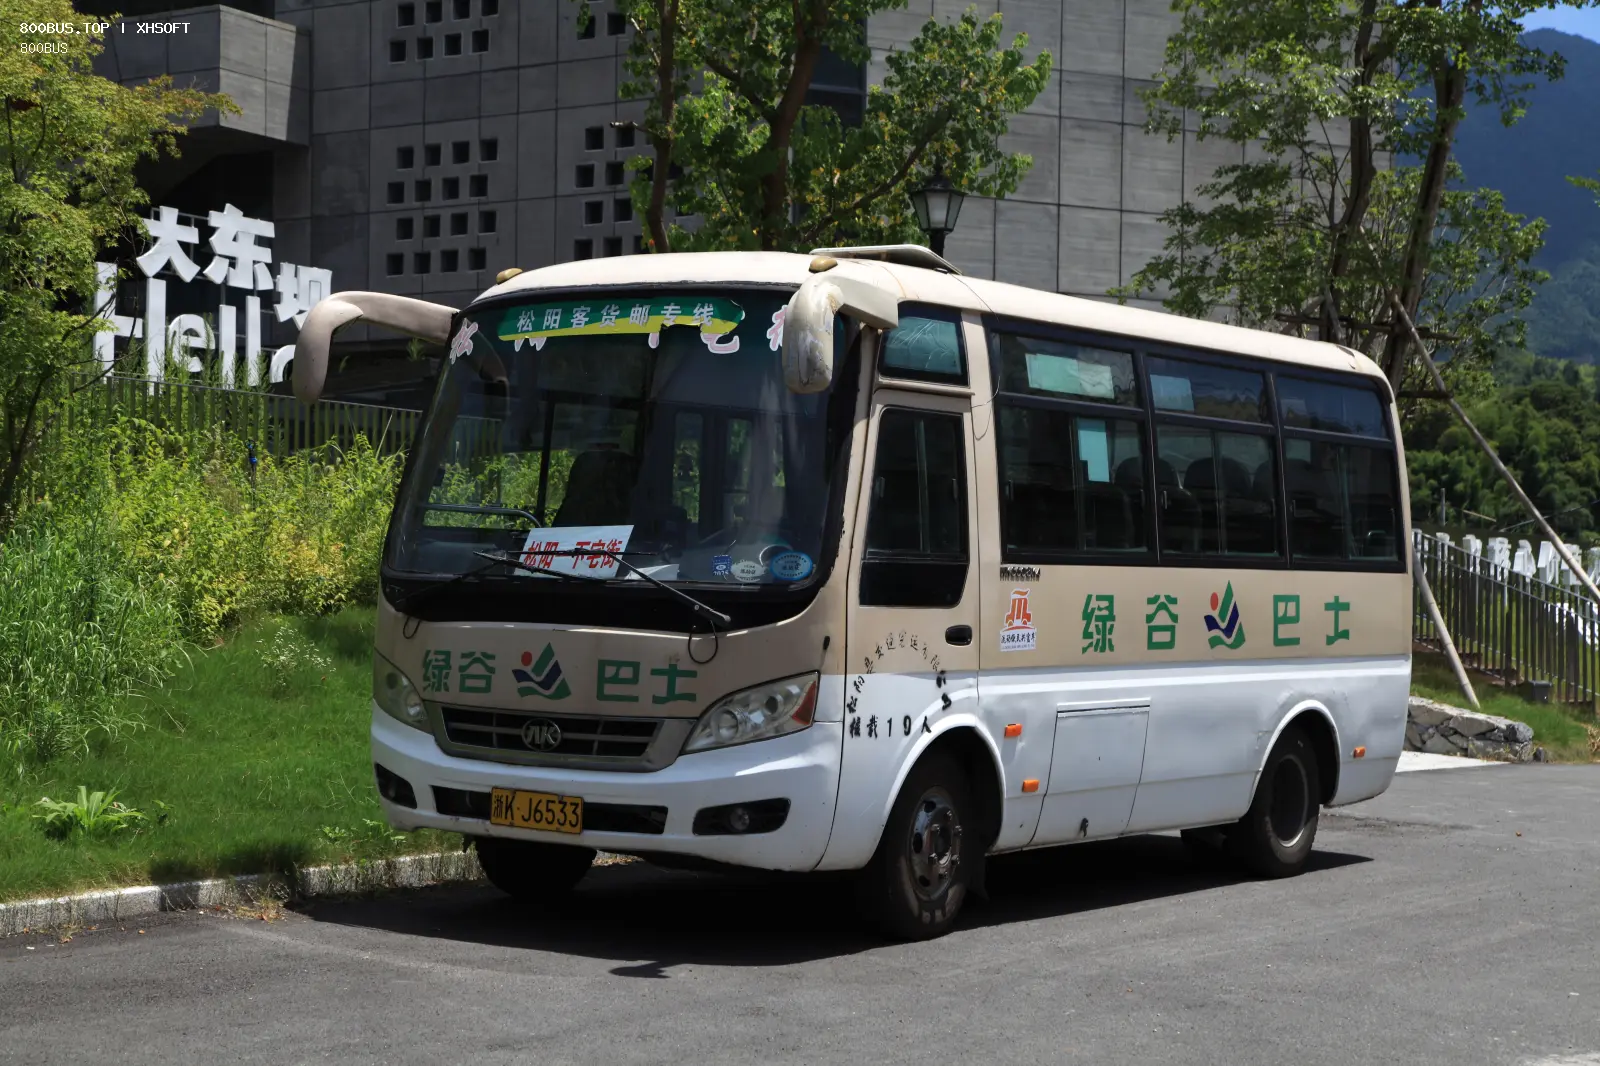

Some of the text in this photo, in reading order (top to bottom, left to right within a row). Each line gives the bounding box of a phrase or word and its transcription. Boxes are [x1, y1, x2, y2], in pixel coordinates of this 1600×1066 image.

[516, 302, 715, 333] 松阳客货邮专线
